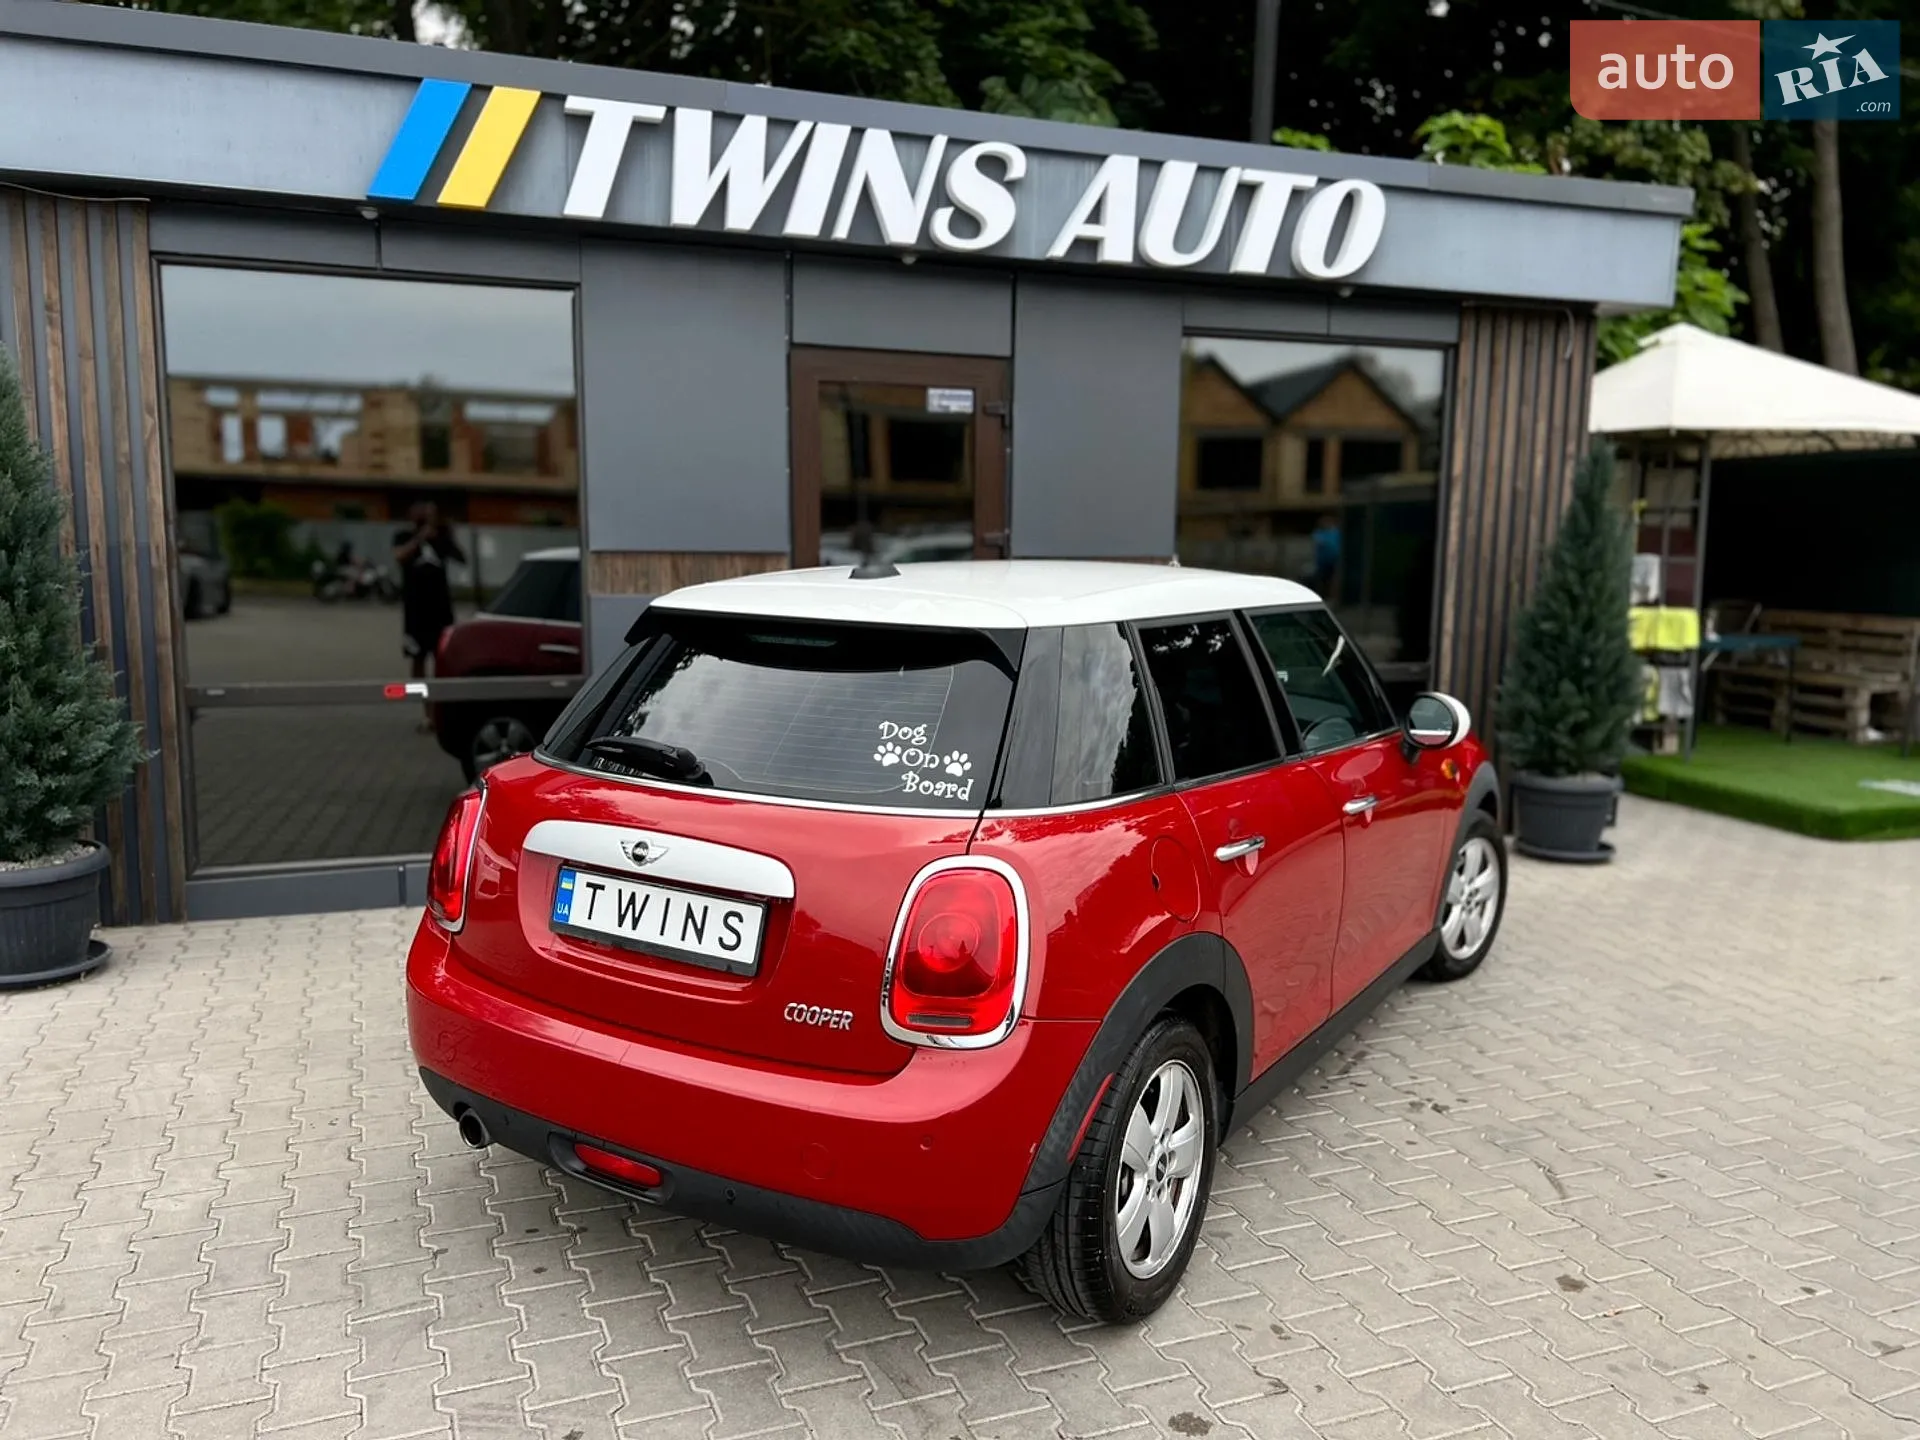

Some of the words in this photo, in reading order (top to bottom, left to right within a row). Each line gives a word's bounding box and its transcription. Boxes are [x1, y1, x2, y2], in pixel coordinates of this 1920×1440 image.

[563, 94, 1027, 252] TWINS
[1045, 153, 1386, 279] AUTO
[879, 720, 928, 746] Dog
[902, 748, 940, 769] On
[901, 770, 975, 802] Board
[557, 903, 569, 917] UA
[586, 881, 744, 952] TWINS
[783, 1002, 854, 1031] COOPER
